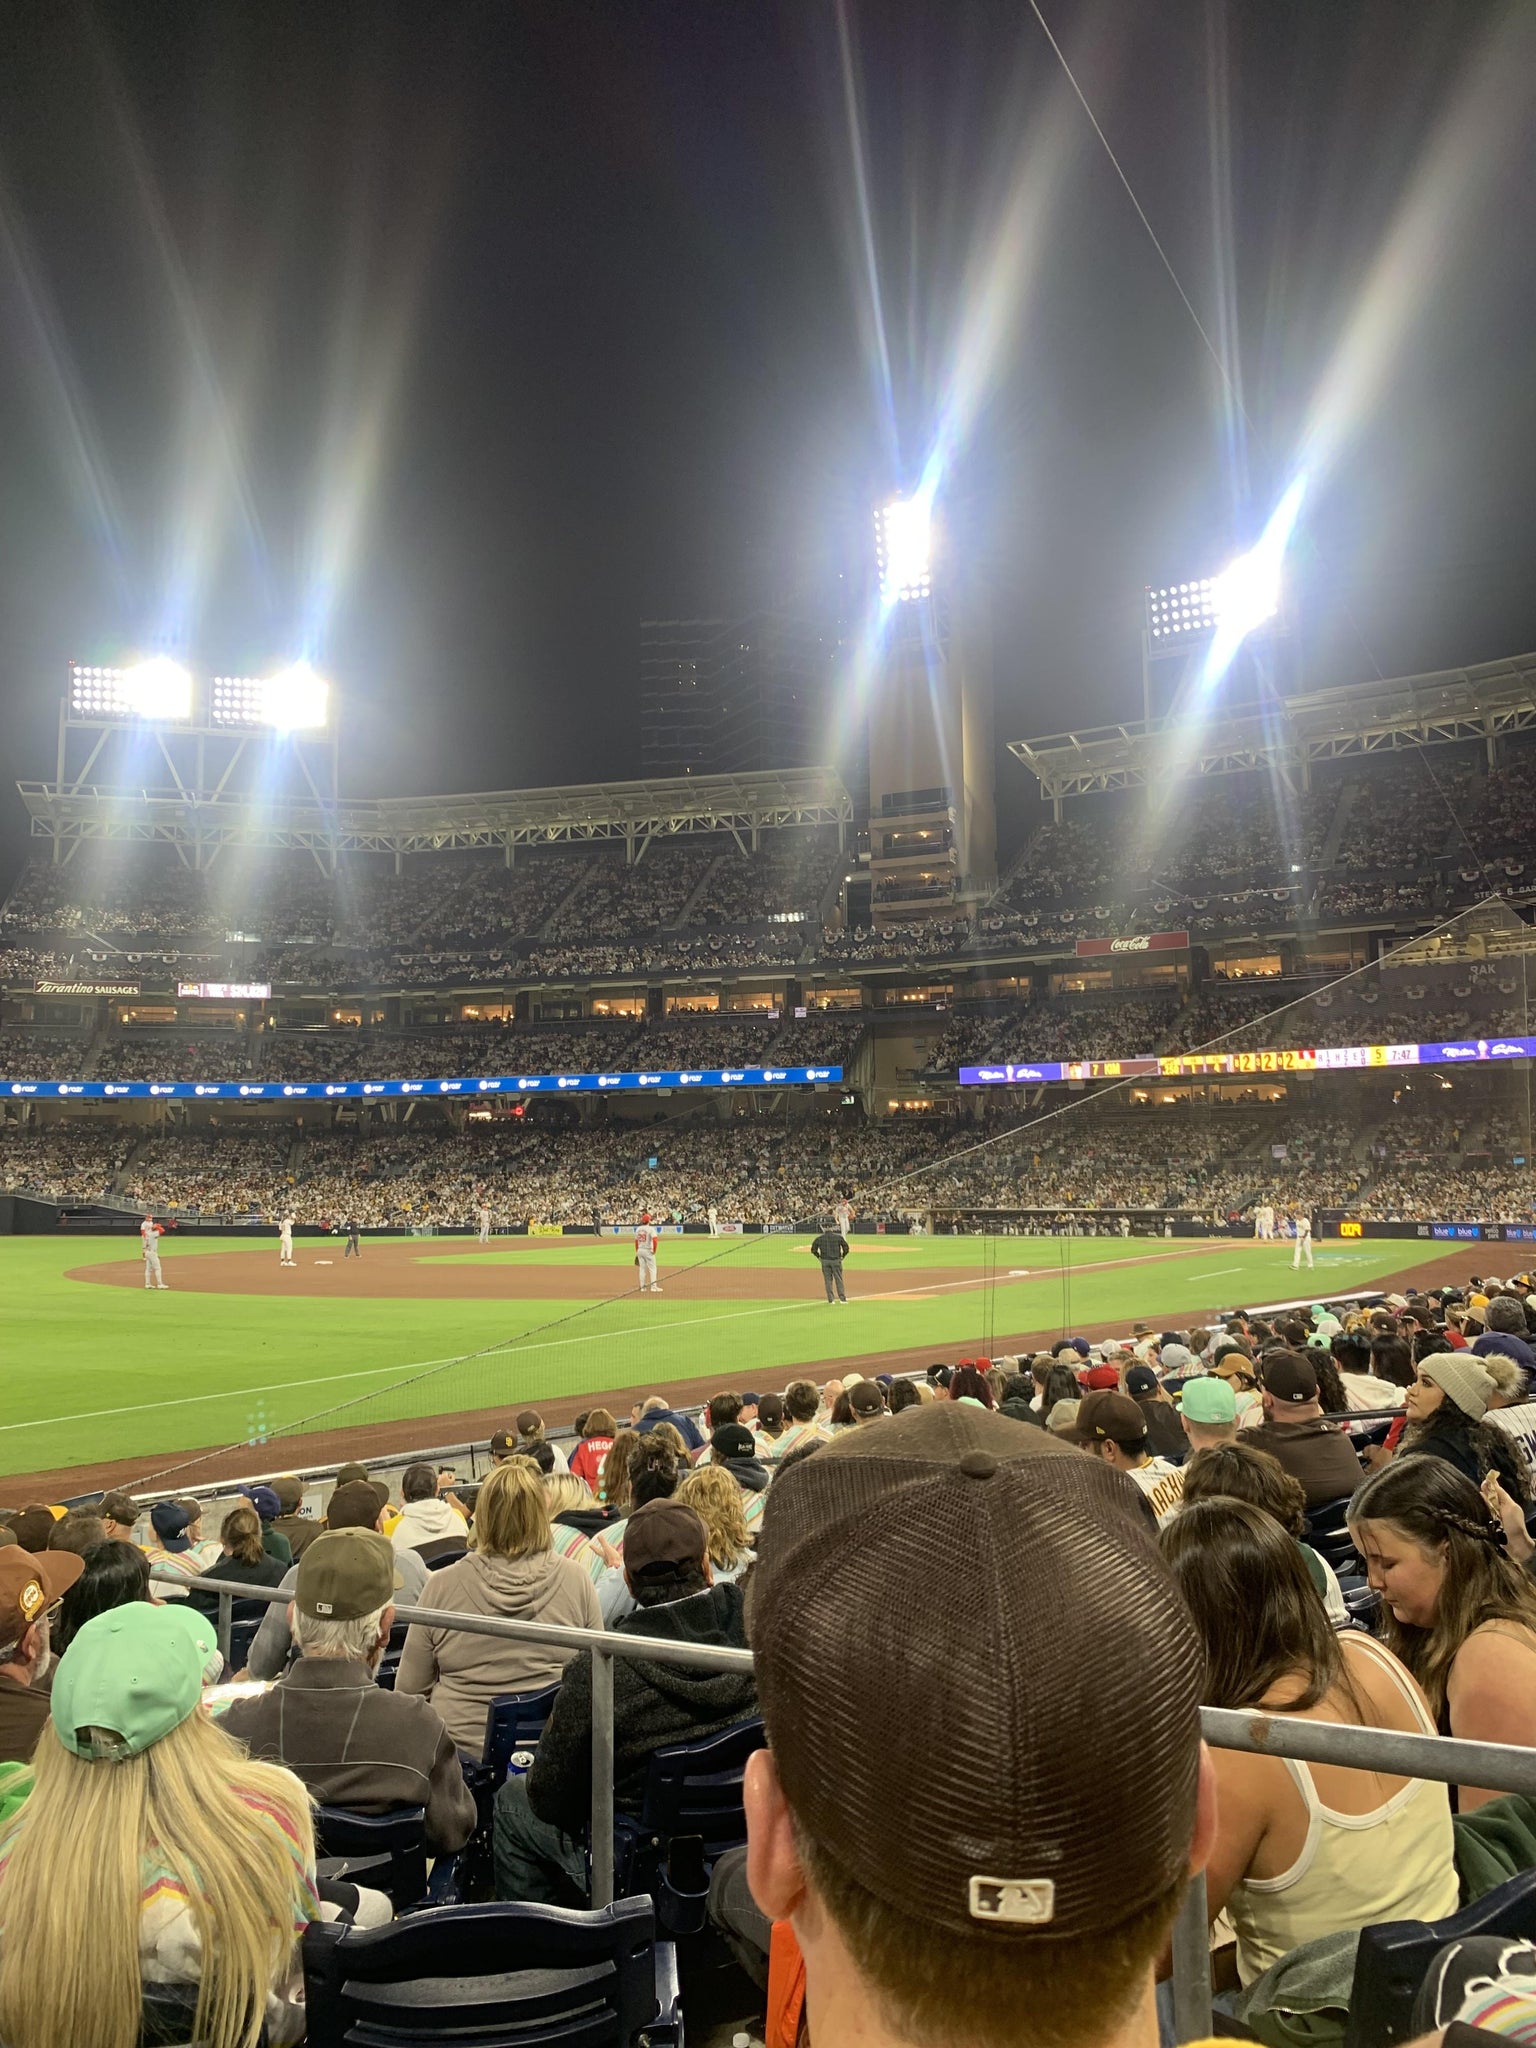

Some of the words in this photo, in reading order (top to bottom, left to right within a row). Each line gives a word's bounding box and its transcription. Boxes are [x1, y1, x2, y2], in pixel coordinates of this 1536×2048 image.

[1507, 887, 1513, 896] 6
[36, 981, 93, 993] Tarantino
[94, 986, 139, 995] SAUSAGES
[1375, 1049, 1382, 1060] 5
[1392, 1049, 1411, 1061] 7:47
[1243, 1055, 1251, 1070] 2
[1264, 1054, 1272, 1069] 2
[1286, 1052, 1294, 1068] 2
[1434, 1227, 1449, 1236] blue
[1457, 1226, 1472, 1236] blue
